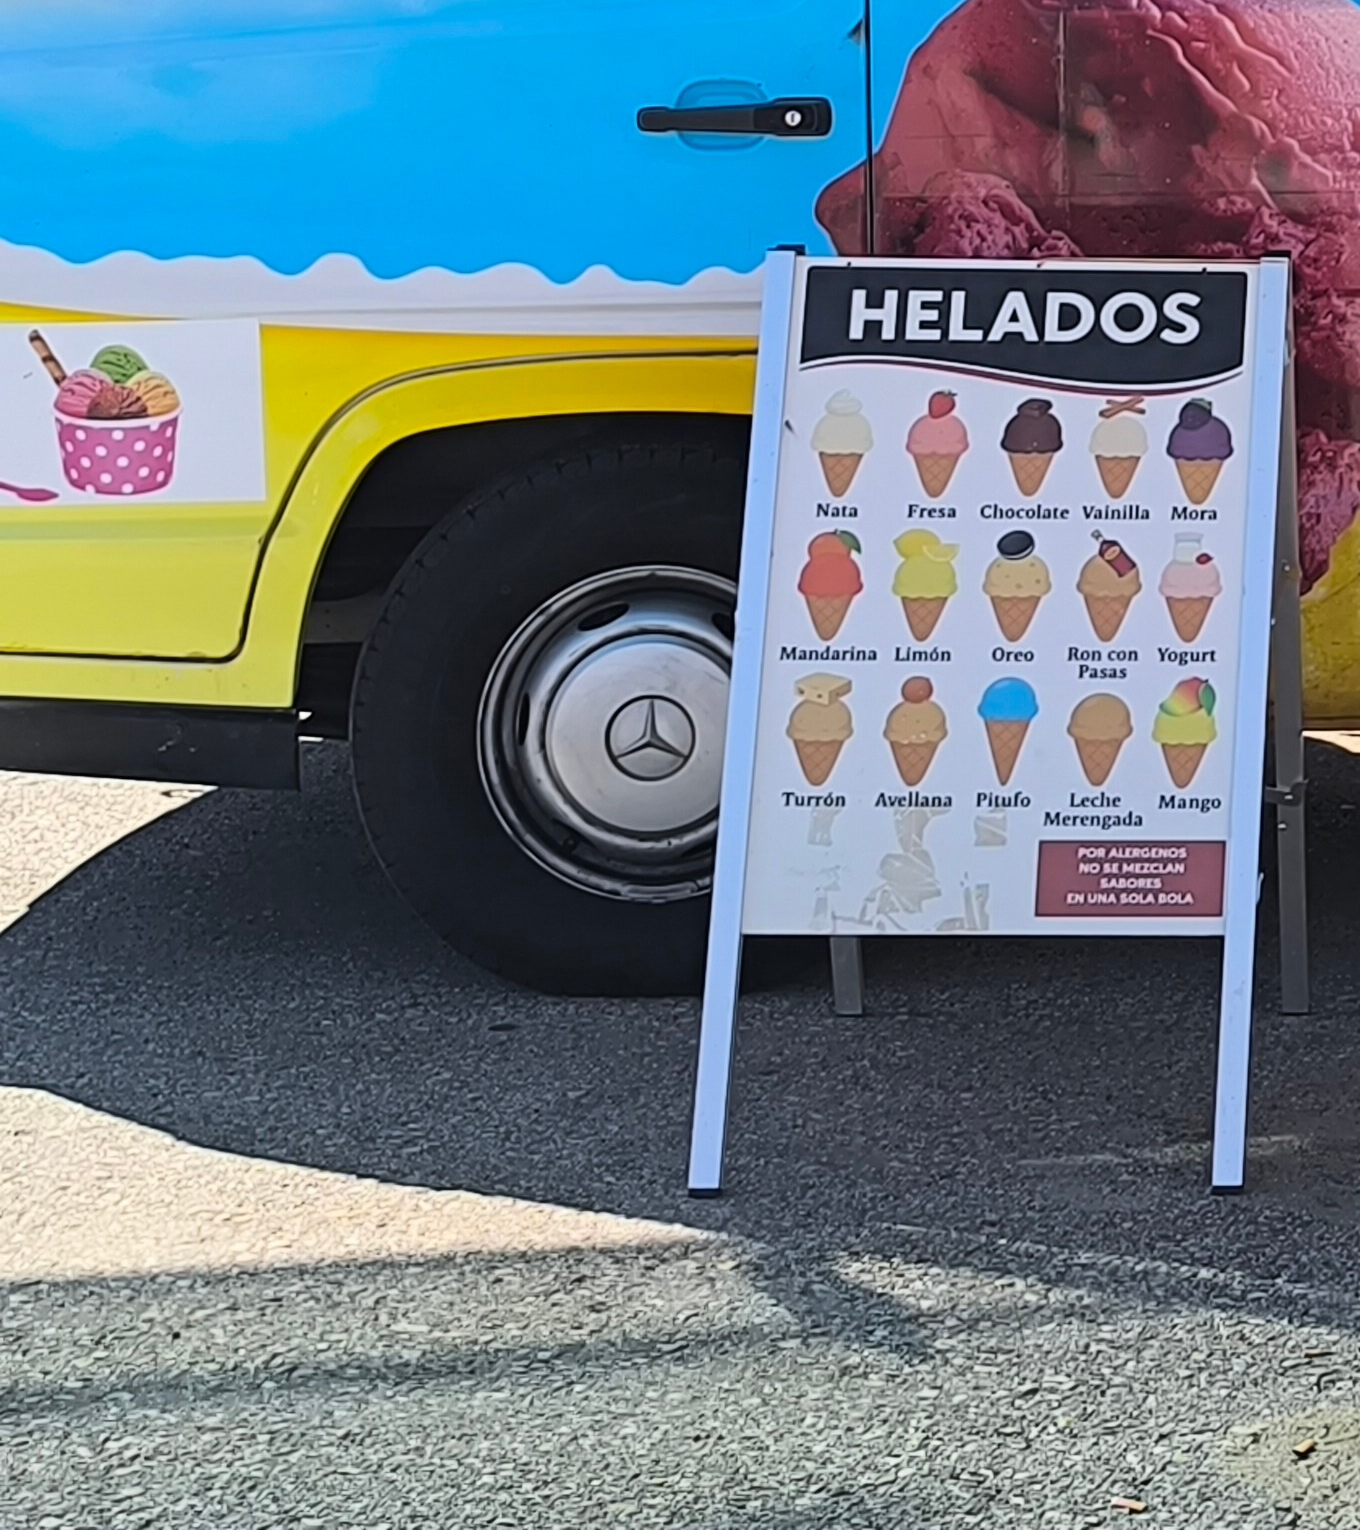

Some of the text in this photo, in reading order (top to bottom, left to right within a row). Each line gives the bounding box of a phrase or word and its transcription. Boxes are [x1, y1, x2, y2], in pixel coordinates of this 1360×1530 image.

[847, 287, 1204, 346] HELADOS
[815, 503, 859, 519] Nata
[906, 504, 958, 520] Fresa
[979, 504, 1071, 521] Chocolate
[1081, 504, 1151, 521] Vainilla
[1170, 506, 1218, 522] Mora
[779, 646, 878, 663] Mandarina
[894, 646, 952, 663] Limón
[991, 647, 1035, 663] Oreo
[1067, 646, 1139, 663] Ron con
[1157, 646, 1217, 667] Yogurt
[1078, 664, 1128, 680] Pasas
[782, 791, 846, 808] Turrón
[874, 791, 953, 808] Avellana
[975, 791, 1032, 809] Pitufo
[1069, 792, 1122, 808] Leche
[1158, 794, 1222, 812] Mango
[1043, 811, 1144, 830] Merengada
[1077, 846, 1106, 859] POR
[1078, 862, 1185, 874] NO SE MEZCLAN
[1099, 877, 1162, 890] SABORES
[1065, 892, 1195, 905] EN UNA SOLA BOLA
